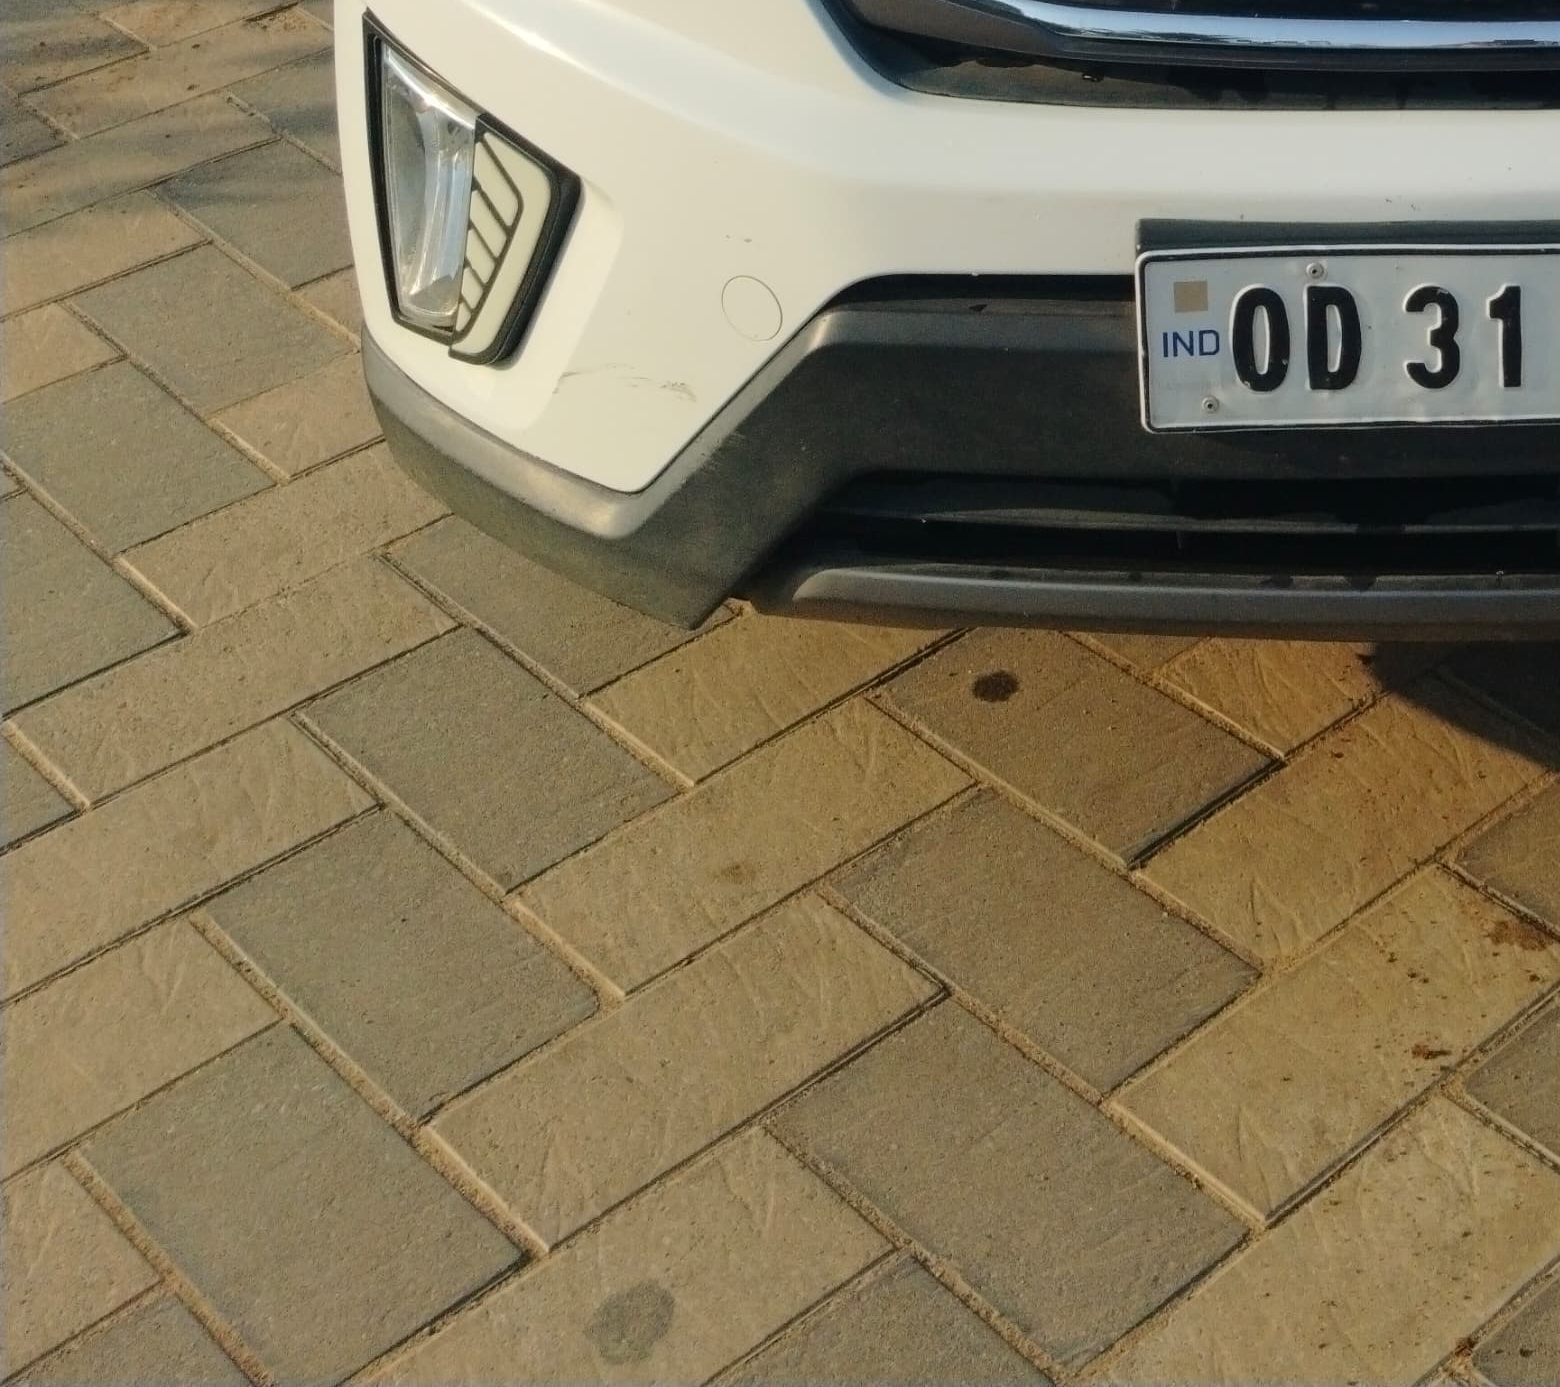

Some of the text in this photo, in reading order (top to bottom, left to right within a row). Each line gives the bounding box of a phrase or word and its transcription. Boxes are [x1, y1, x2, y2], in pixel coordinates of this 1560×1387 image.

[1162, 329, 1221, 359] IND
[1231, 283, 1362, 392] OD
[1403, 285, 1522, 389] 31
